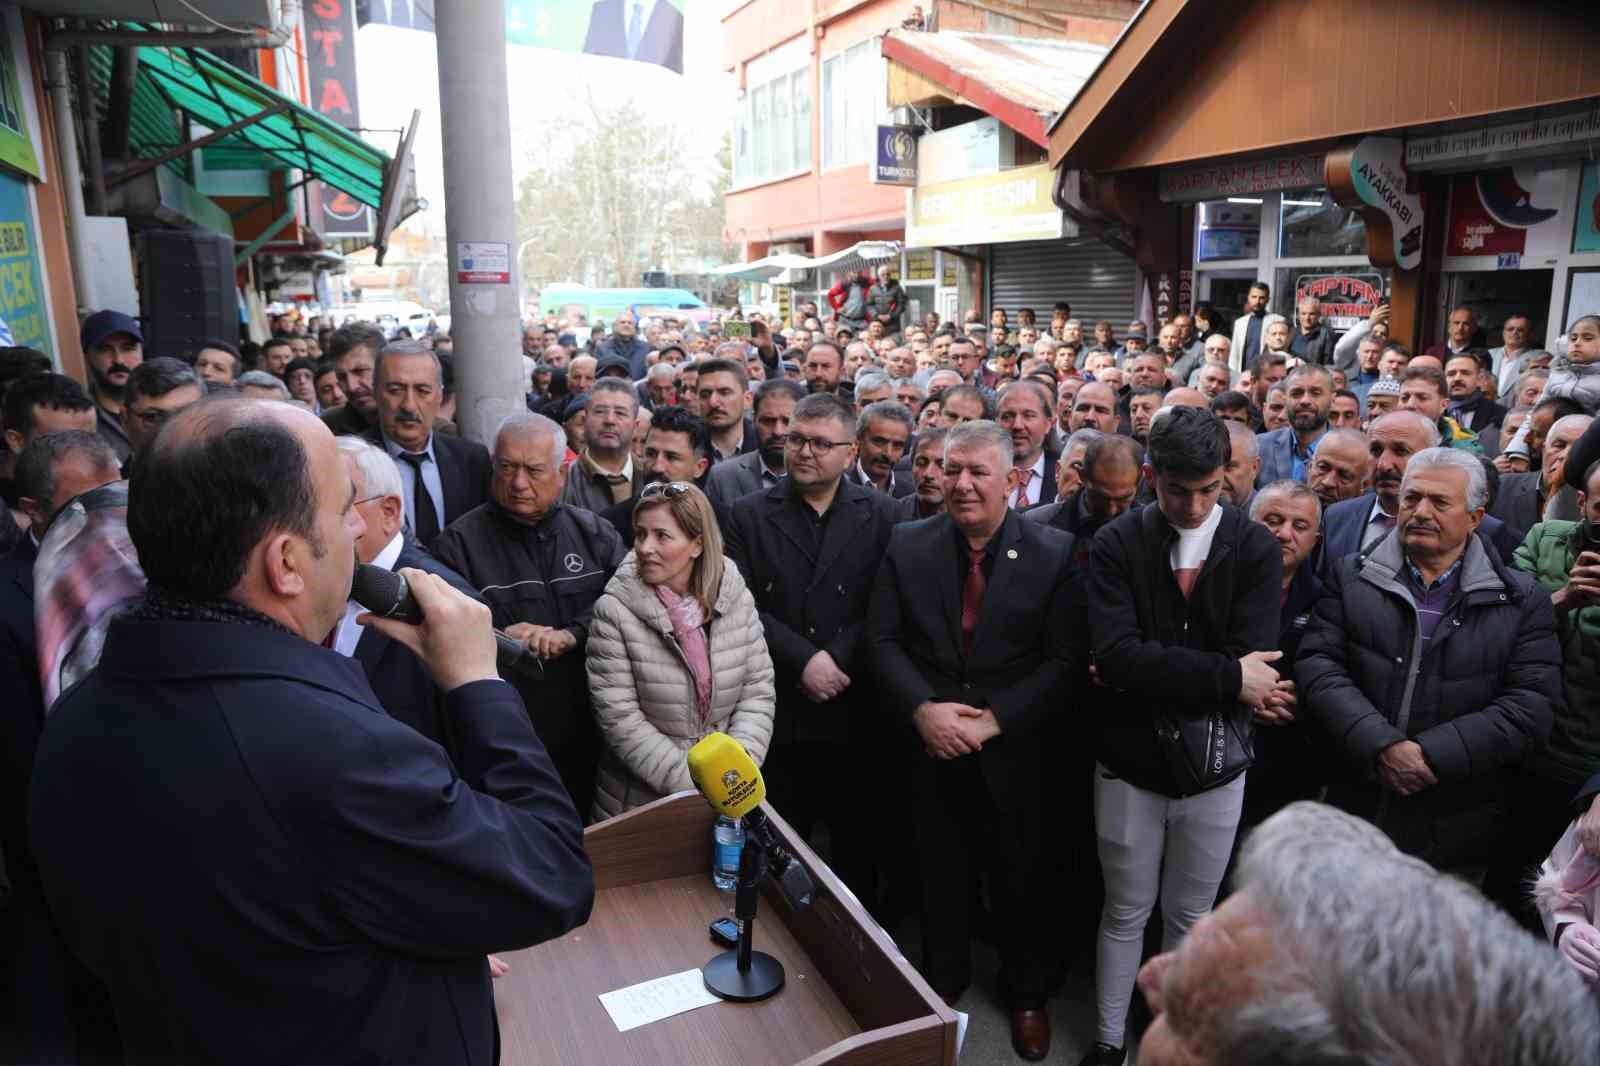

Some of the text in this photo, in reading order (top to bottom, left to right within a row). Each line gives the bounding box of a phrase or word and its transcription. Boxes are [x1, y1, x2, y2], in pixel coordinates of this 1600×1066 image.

[1359, 164, 1413, 224] AYAKKABI
[1297, 276, 1382, 304] KAPTAN
[1216, 738, 1225, 747] IS
[1213, 751, 1224, 774] LOVE
